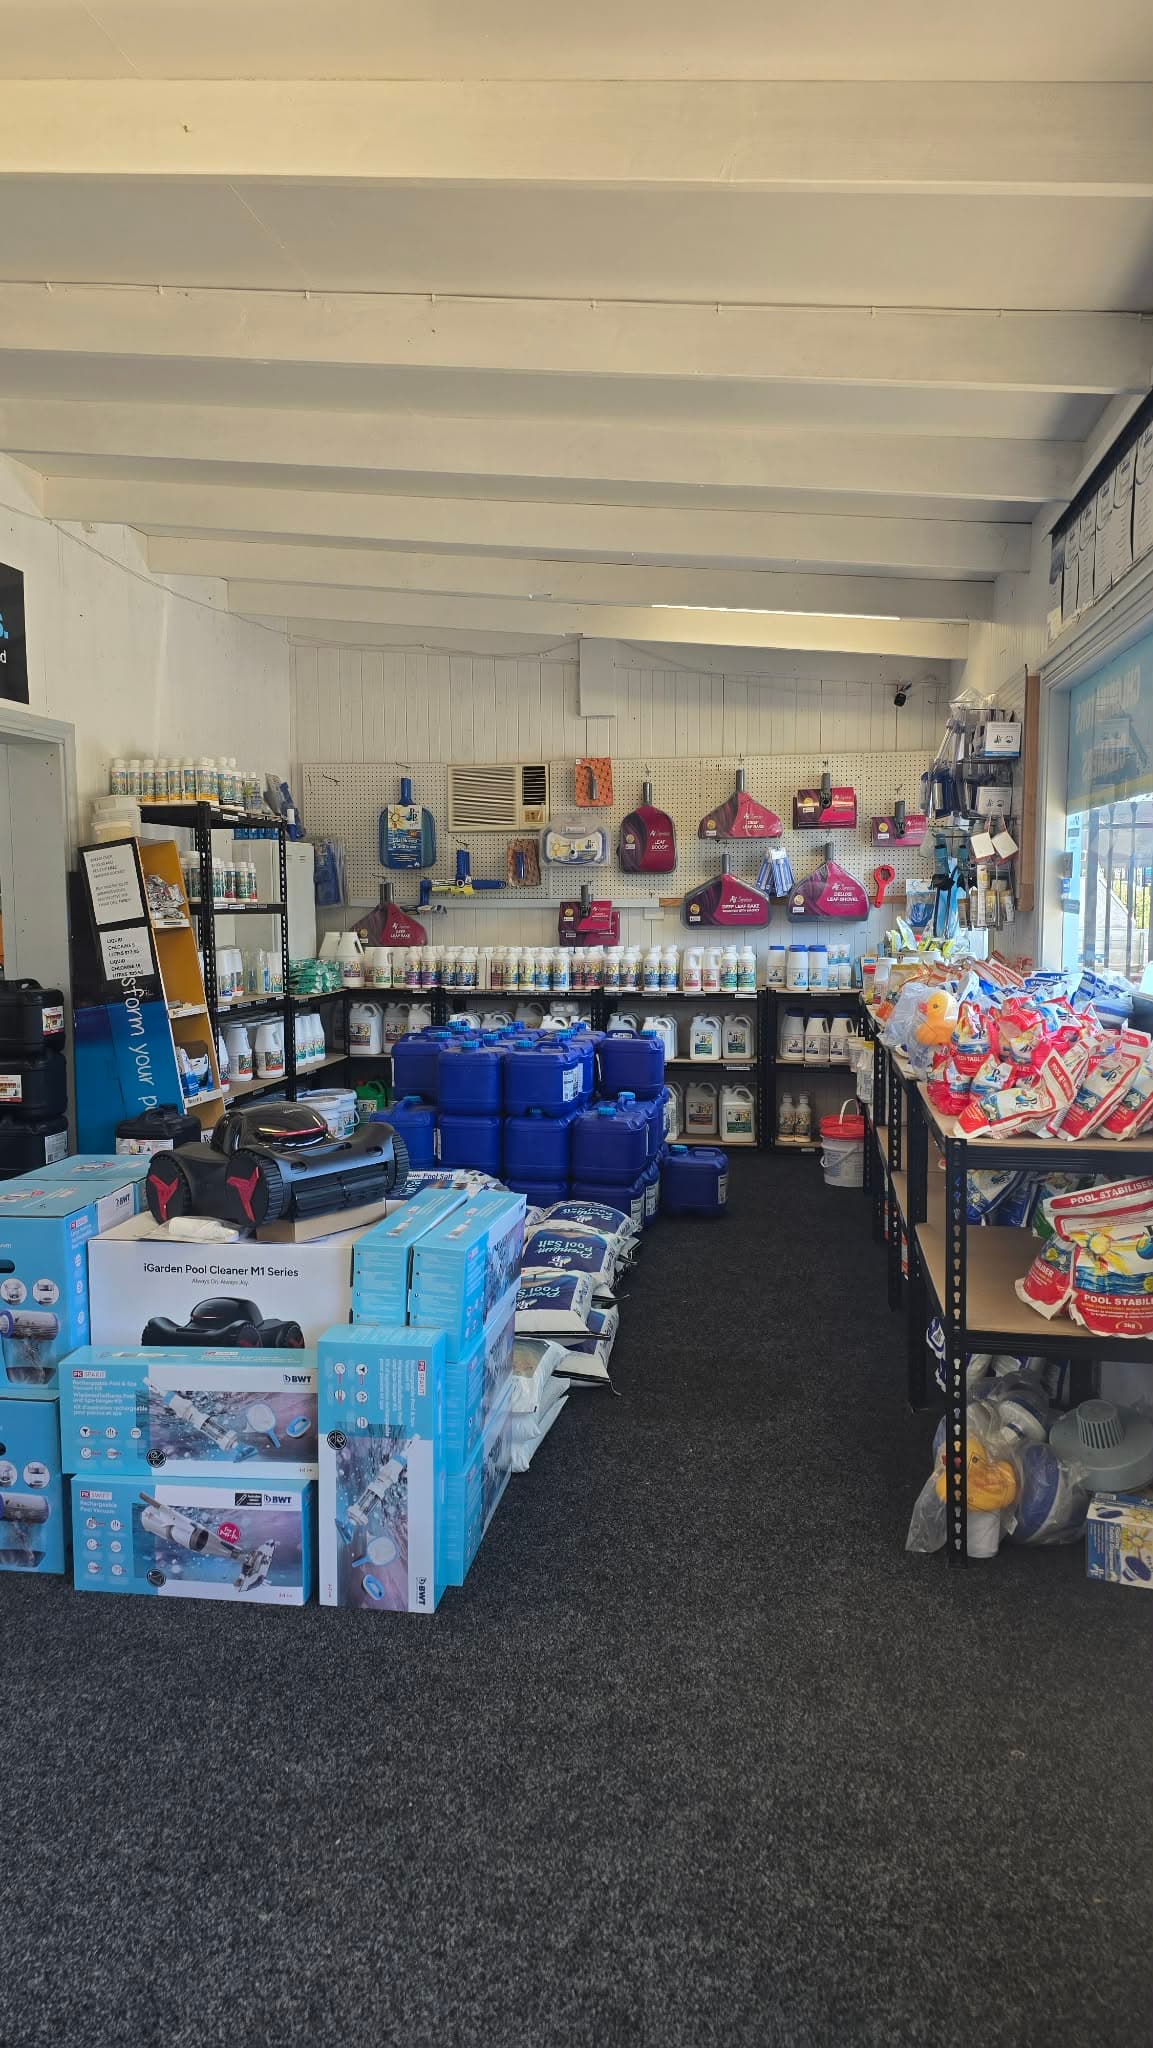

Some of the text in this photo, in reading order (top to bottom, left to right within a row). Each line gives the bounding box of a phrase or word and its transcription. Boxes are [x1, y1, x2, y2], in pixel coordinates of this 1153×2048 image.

[128, 1042, 154, 1086] your
[1070, 1180, 1153, 1205] POOL STABILISER
[538, 1246, 592, 1259] Premium
[566, 1241, 592, 1252] Pool
[144, 1263, 298, 1277] iGarden Pool Cleaner M1 Series
[1084, 1294, 1112, 1304] POOL
